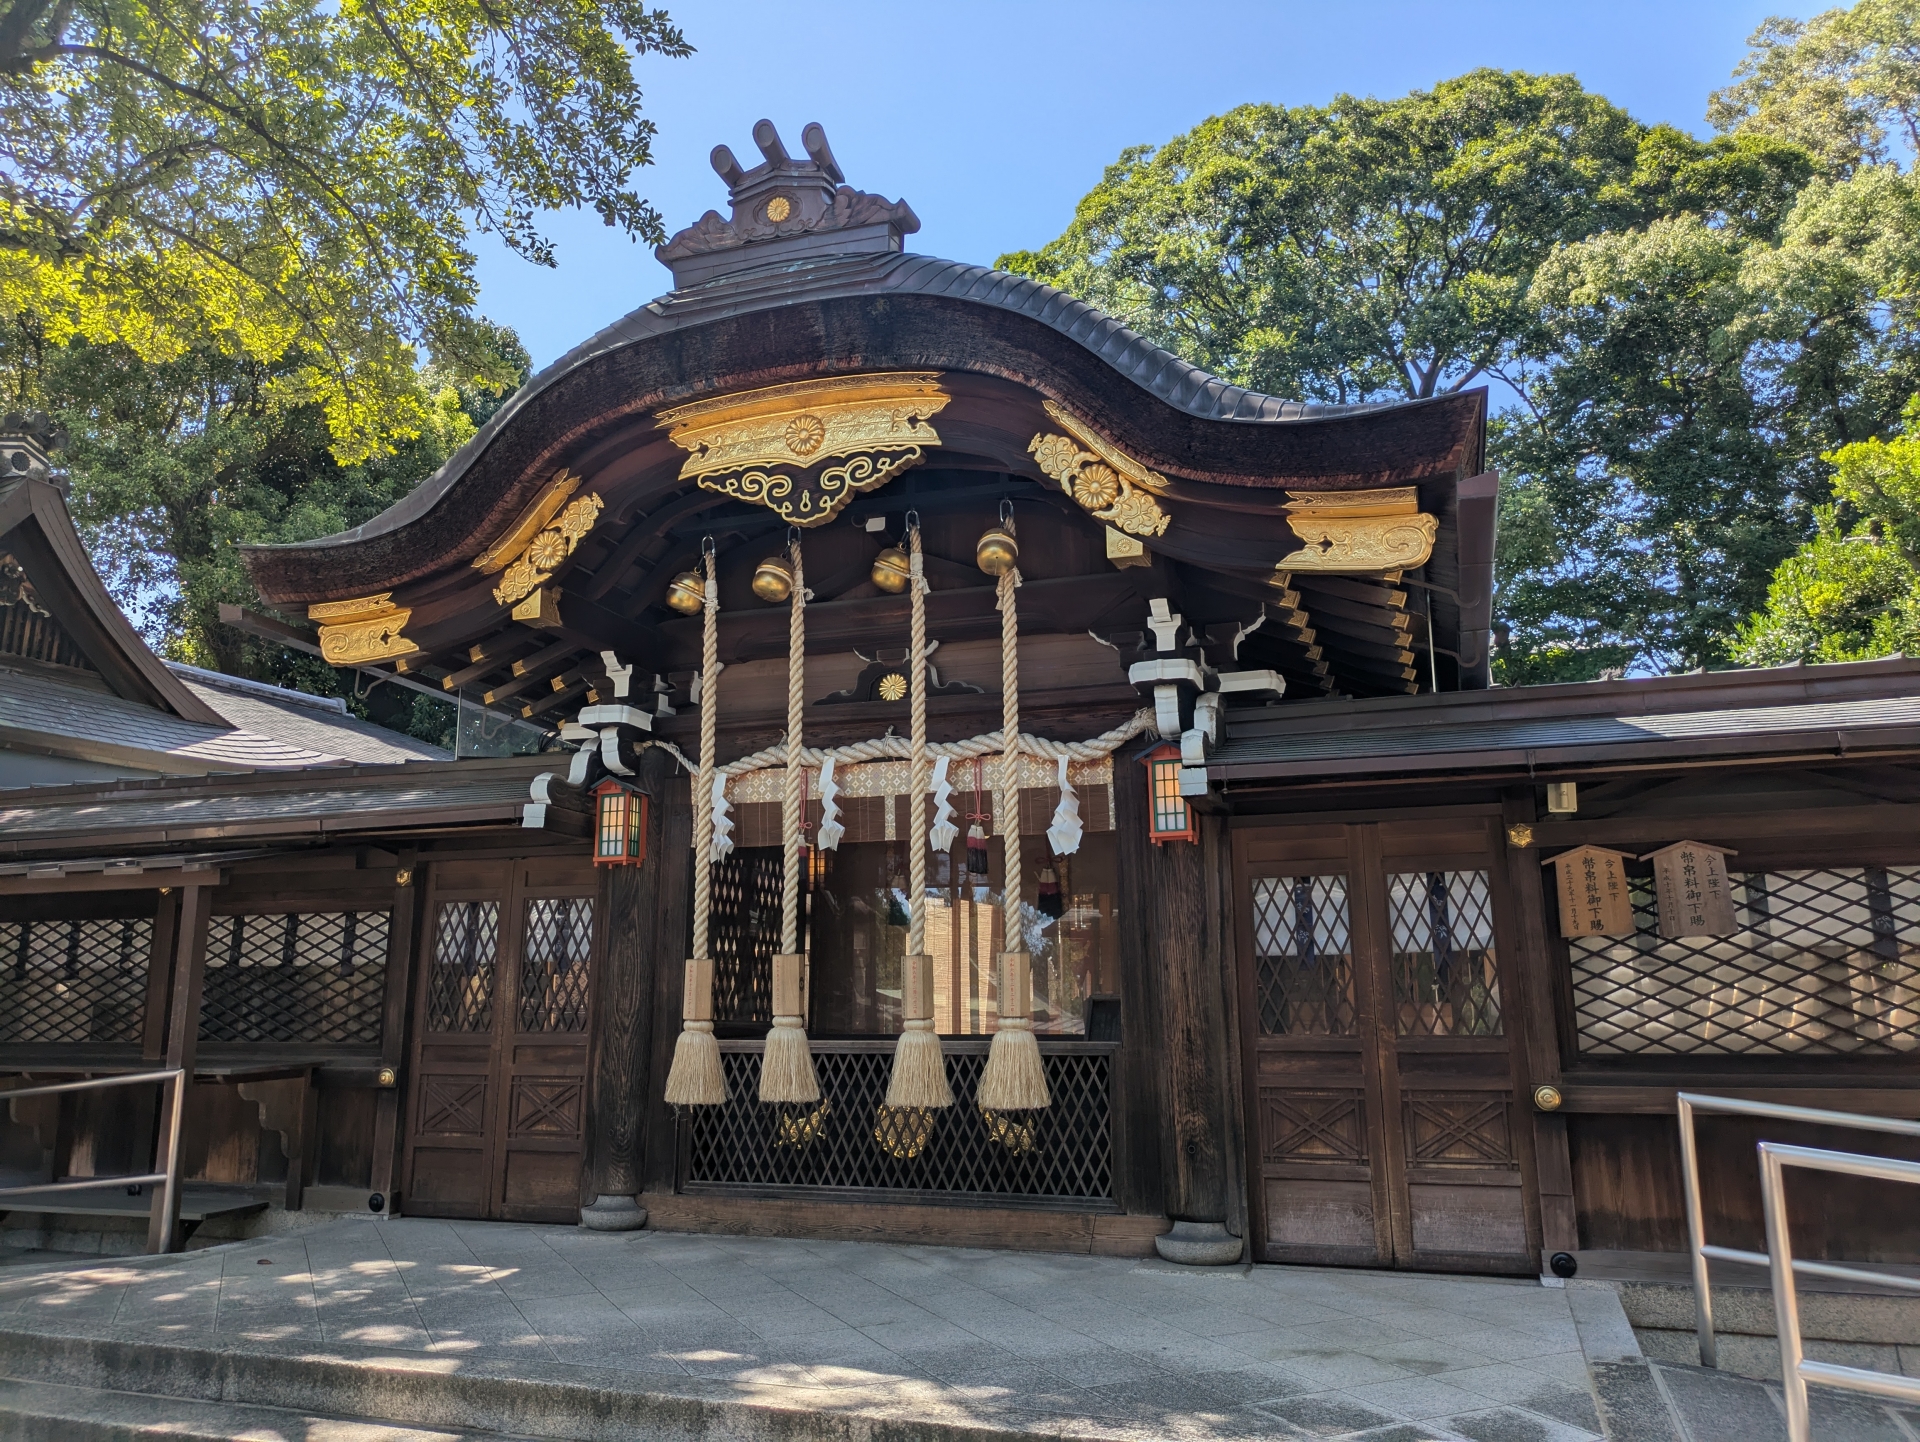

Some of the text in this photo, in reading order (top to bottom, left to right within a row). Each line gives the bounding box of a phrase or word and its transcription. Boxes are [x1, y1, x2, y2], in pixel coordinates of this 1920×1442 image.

[1604, 859, 1620, 901] 今上陛下
[1704, 854, 1721, 900] 今上陛下
